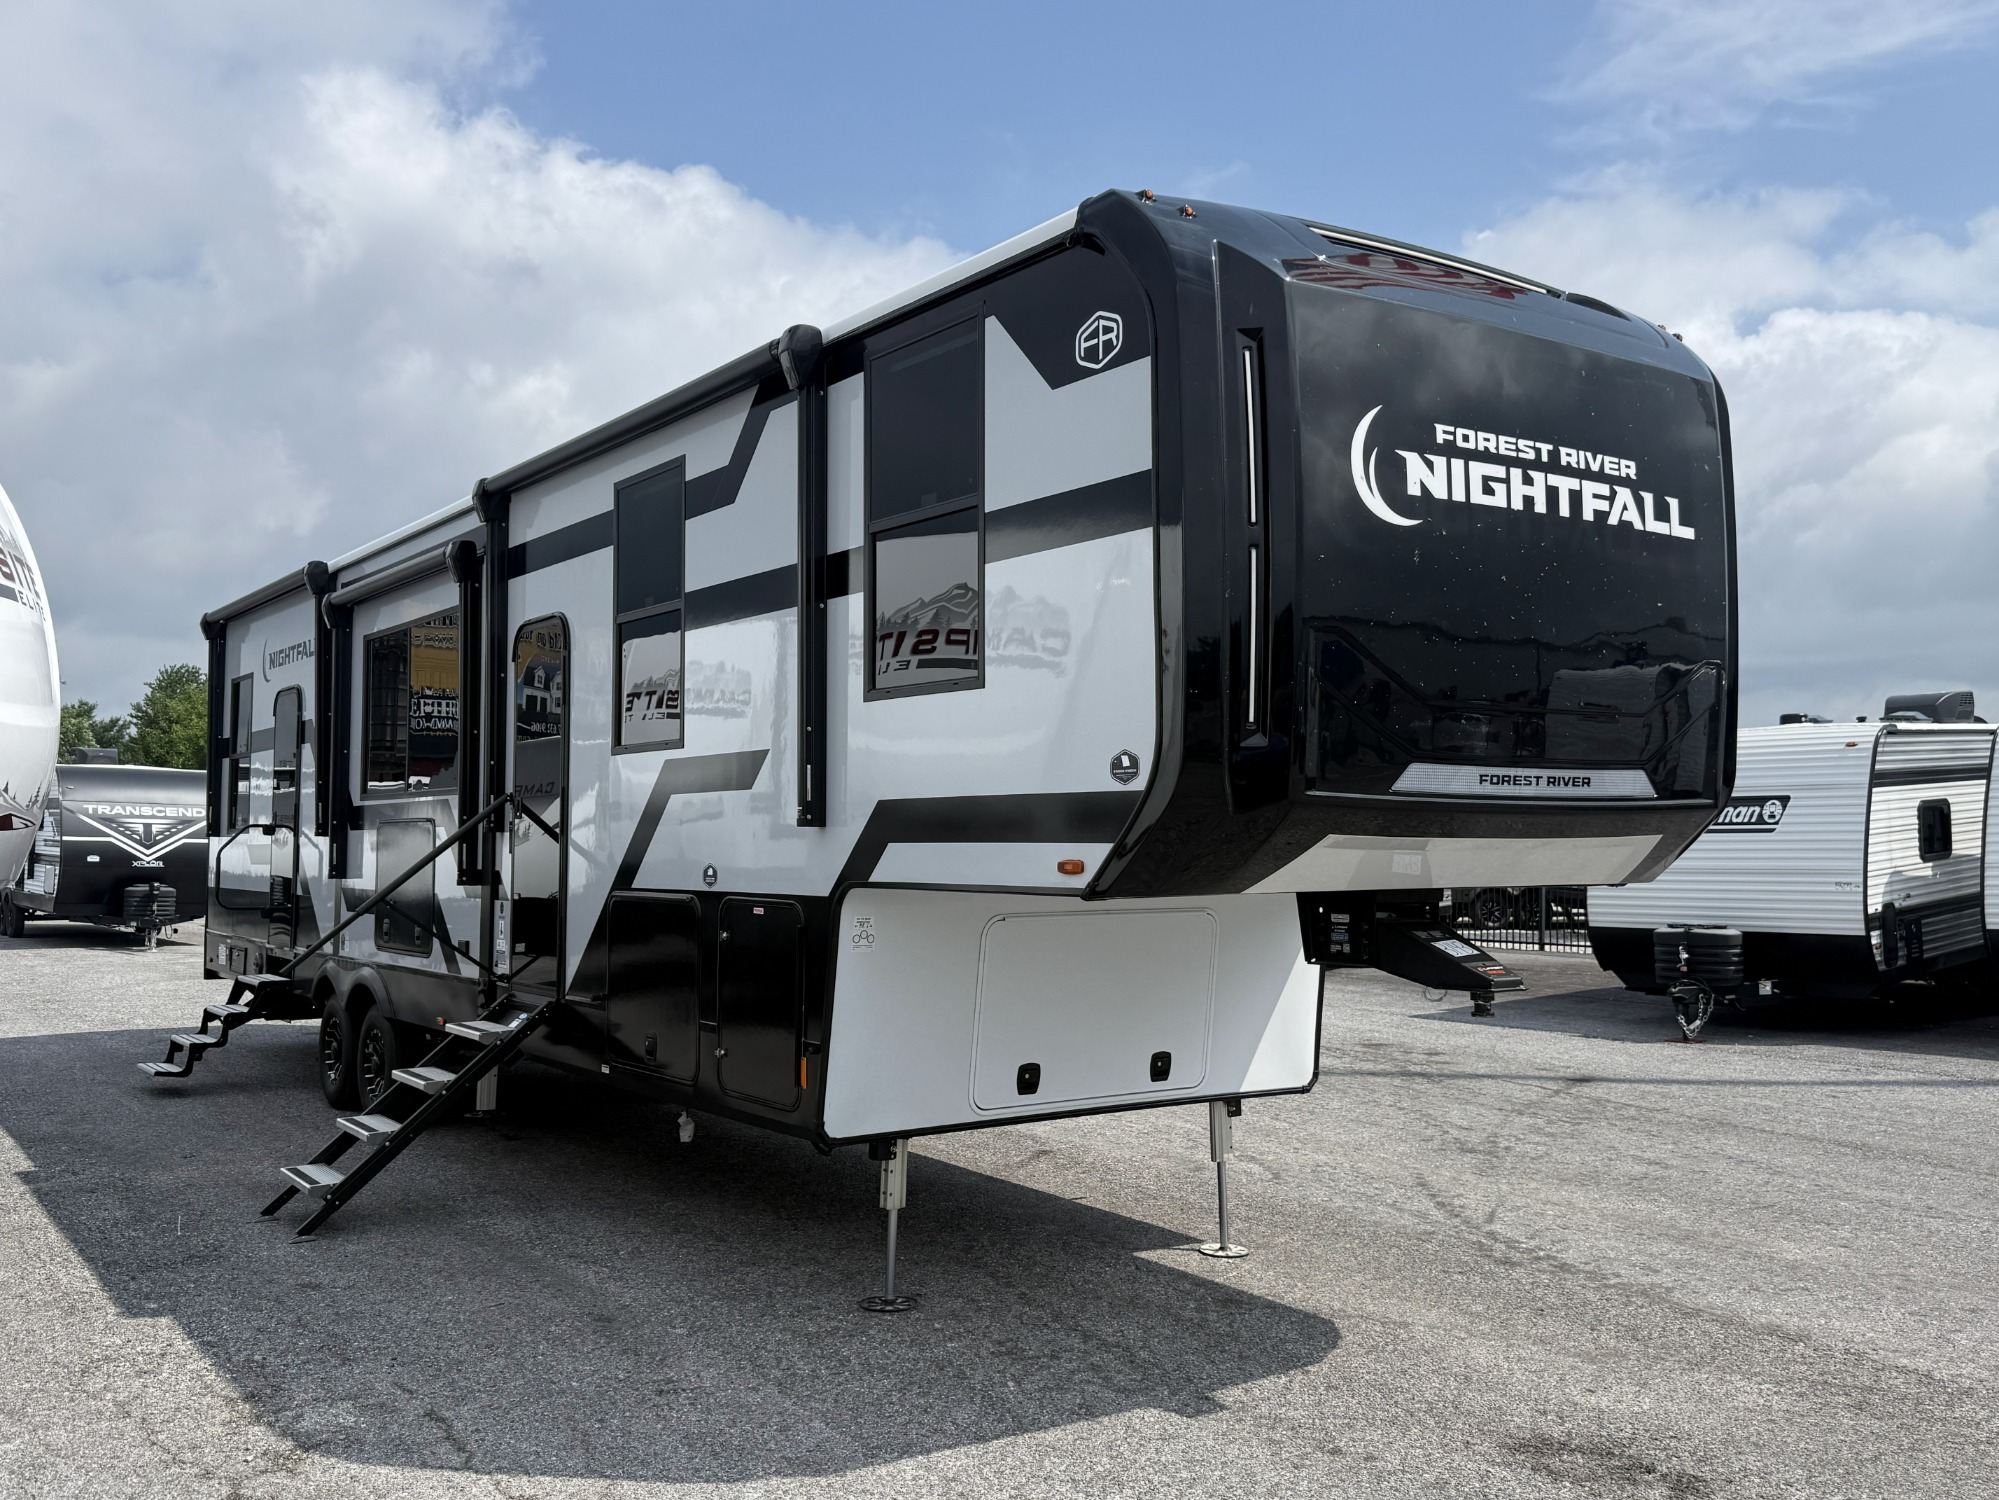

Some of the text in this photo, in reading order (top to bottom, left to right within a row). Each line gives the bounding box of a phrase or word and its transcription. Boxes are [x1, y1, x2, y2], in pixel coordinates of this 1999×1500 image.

[1433, 423, 1638, 480] FOREST RIVER
[1394, 449, 1696, 540] NIGHTFALL
[269, 638, 315, 670] NIGHTFAL
[1479, 774, 1591, 788] FOREST RIVER
[83, 804, 206, 817] TRANSCEND
